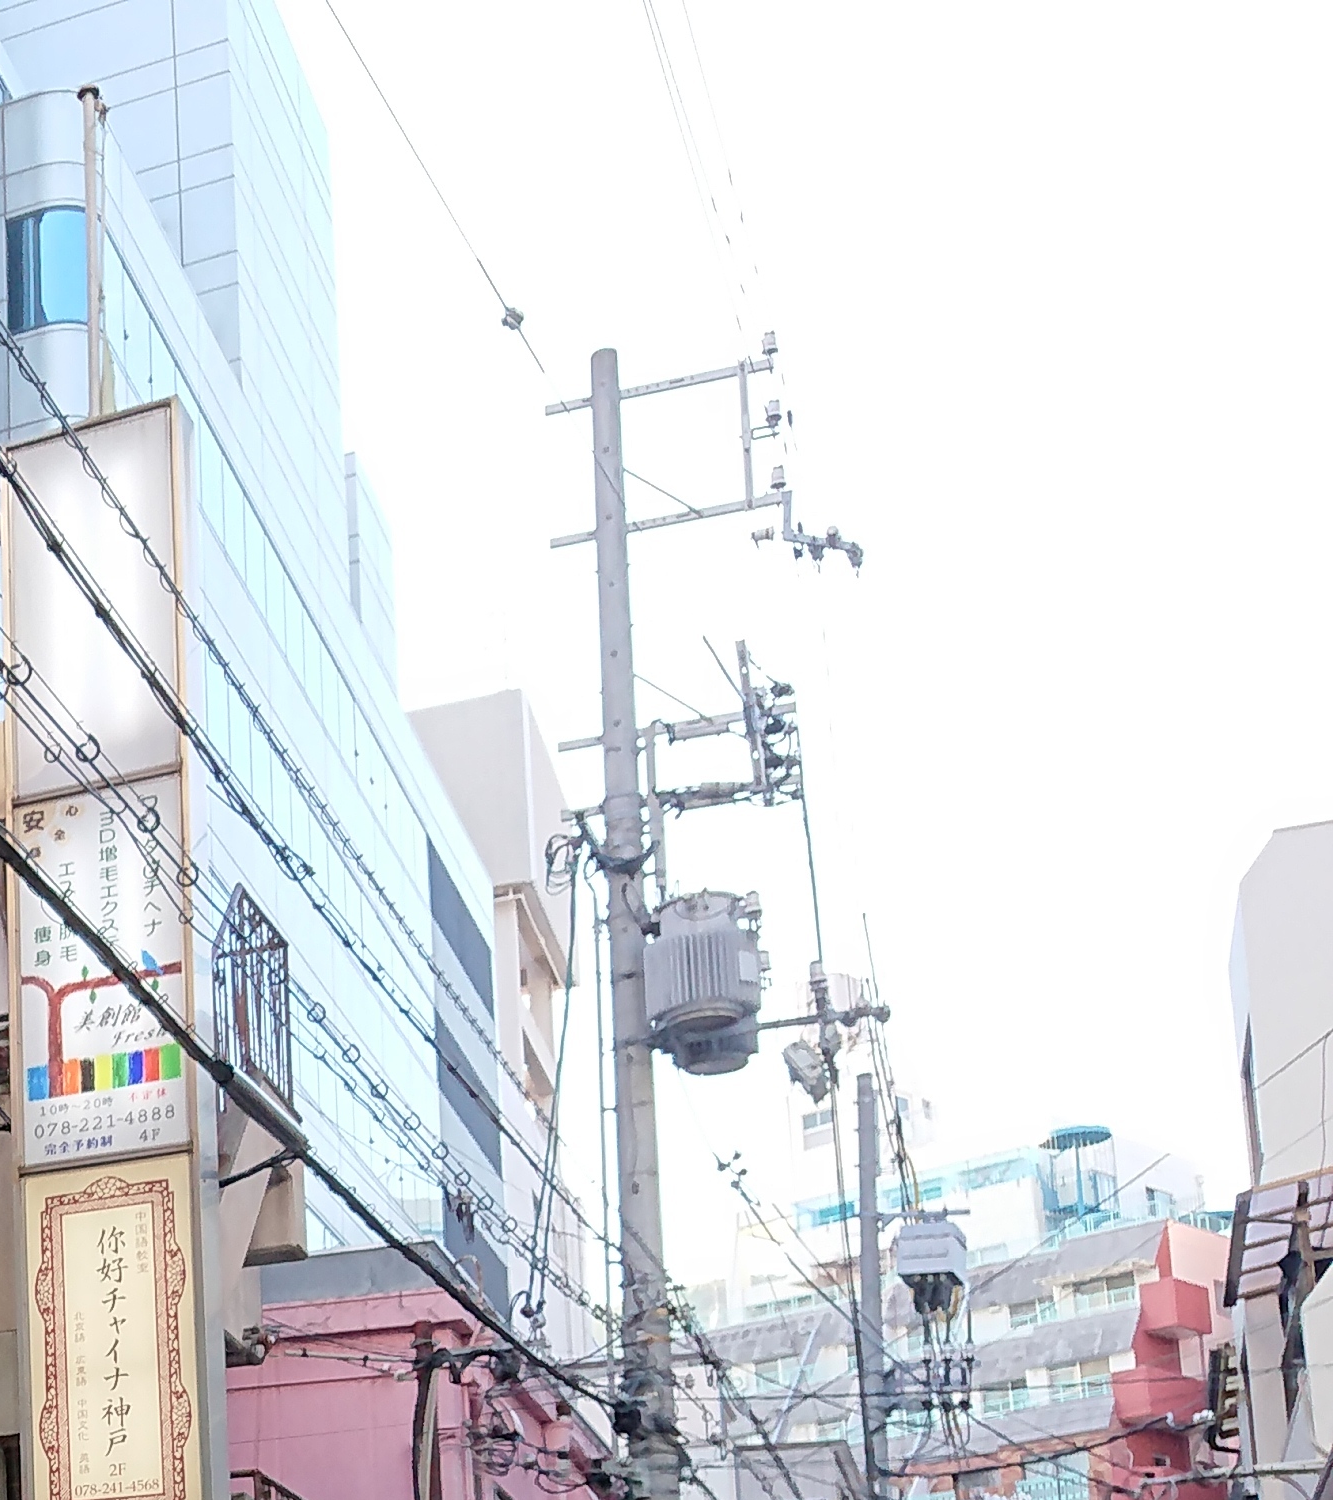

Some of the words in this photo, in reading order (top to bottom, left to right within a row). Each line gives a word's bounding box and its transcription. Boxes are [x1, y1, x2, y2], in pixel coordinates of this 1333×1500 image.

[34, 1104, 175, 1139] 078-221-4888
[139, 1128, 161, 1143] 4F
[95, 1225, 131, 1458] 你好チャイナ神戸
[109, 1463, 126, 1477] 2F
[74, 1479, 160, 1497] 078-241-4568
